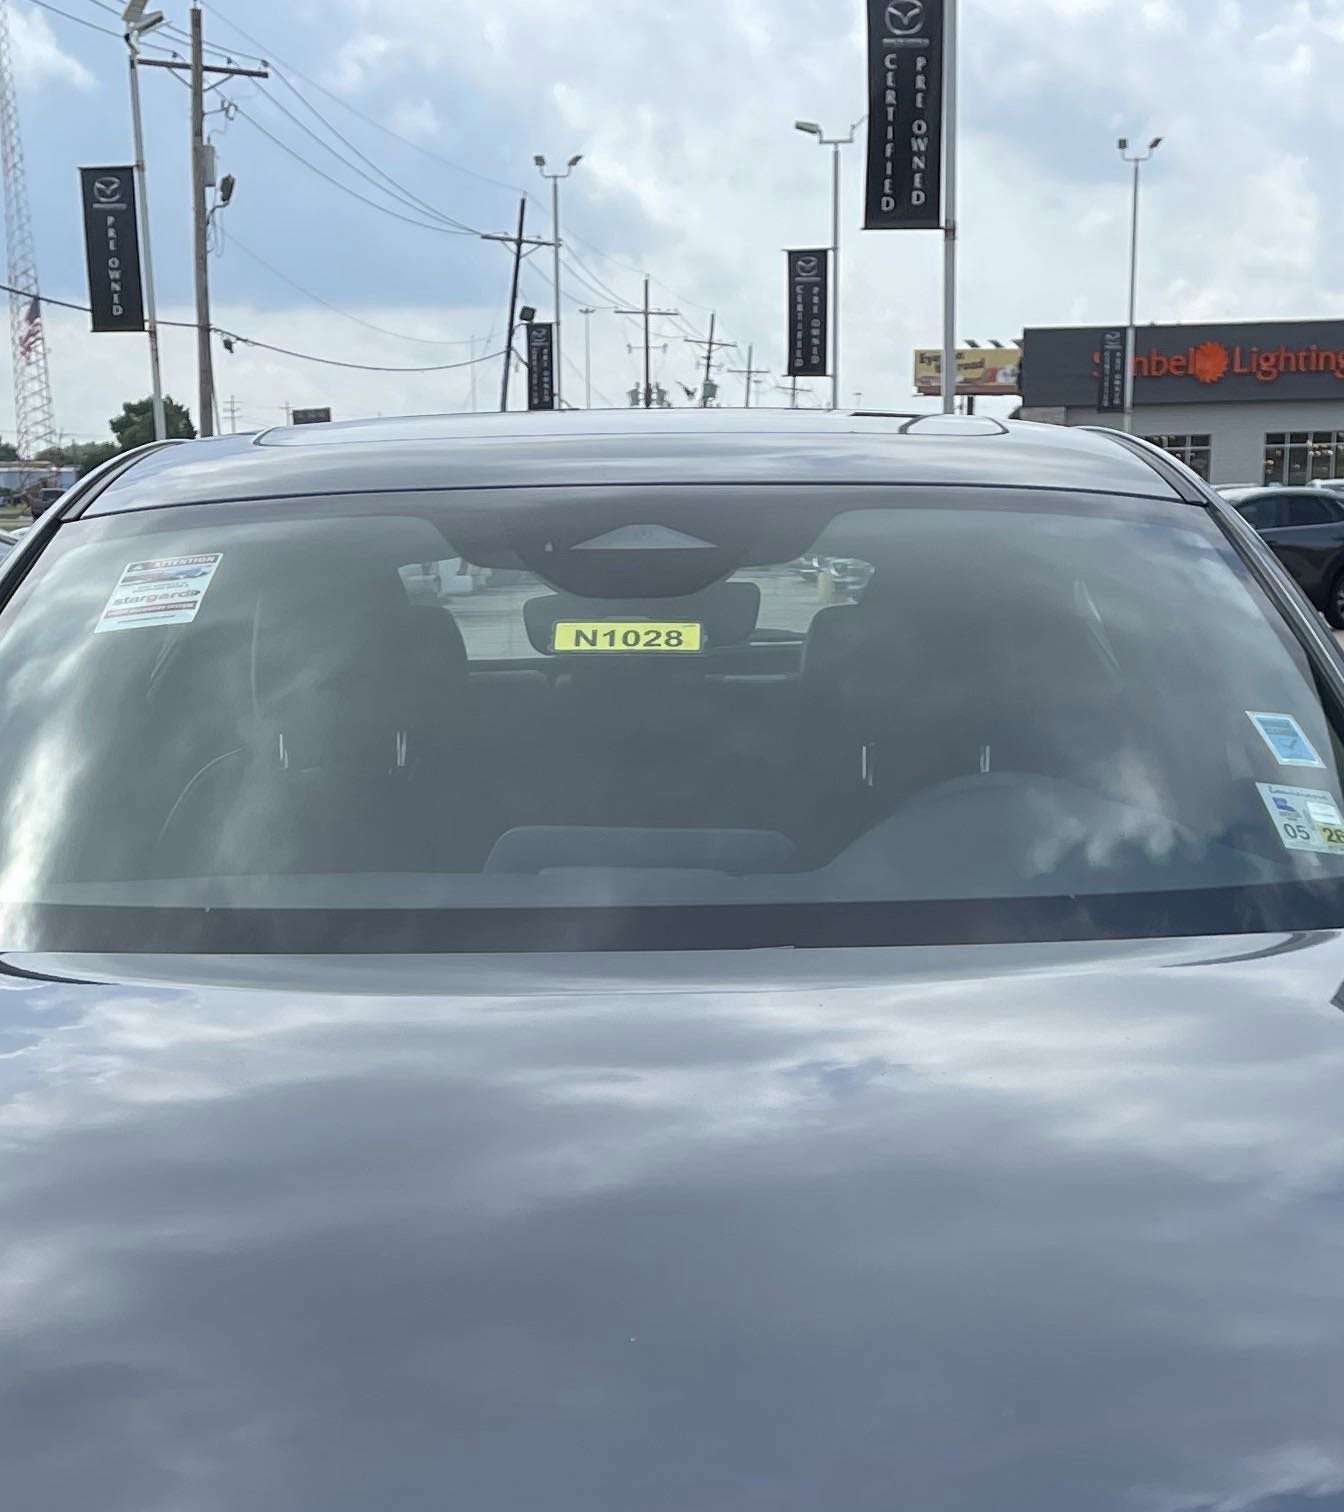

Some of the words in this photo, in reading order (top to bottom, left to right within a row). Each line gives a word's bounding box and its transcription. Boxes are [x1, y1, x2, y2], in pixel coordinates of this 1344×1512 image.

[914, 56, 927, 109] PRE
[881, 53, 898, 212] CERTIFIED
[911, 119, 929, 206] OWNED
[107, 215, 117, 250] PRE
[108, 257, 124, 316] OWNED
[574, 629, 683, 648] N1028
[1284, 823, 1310, 841] 05
